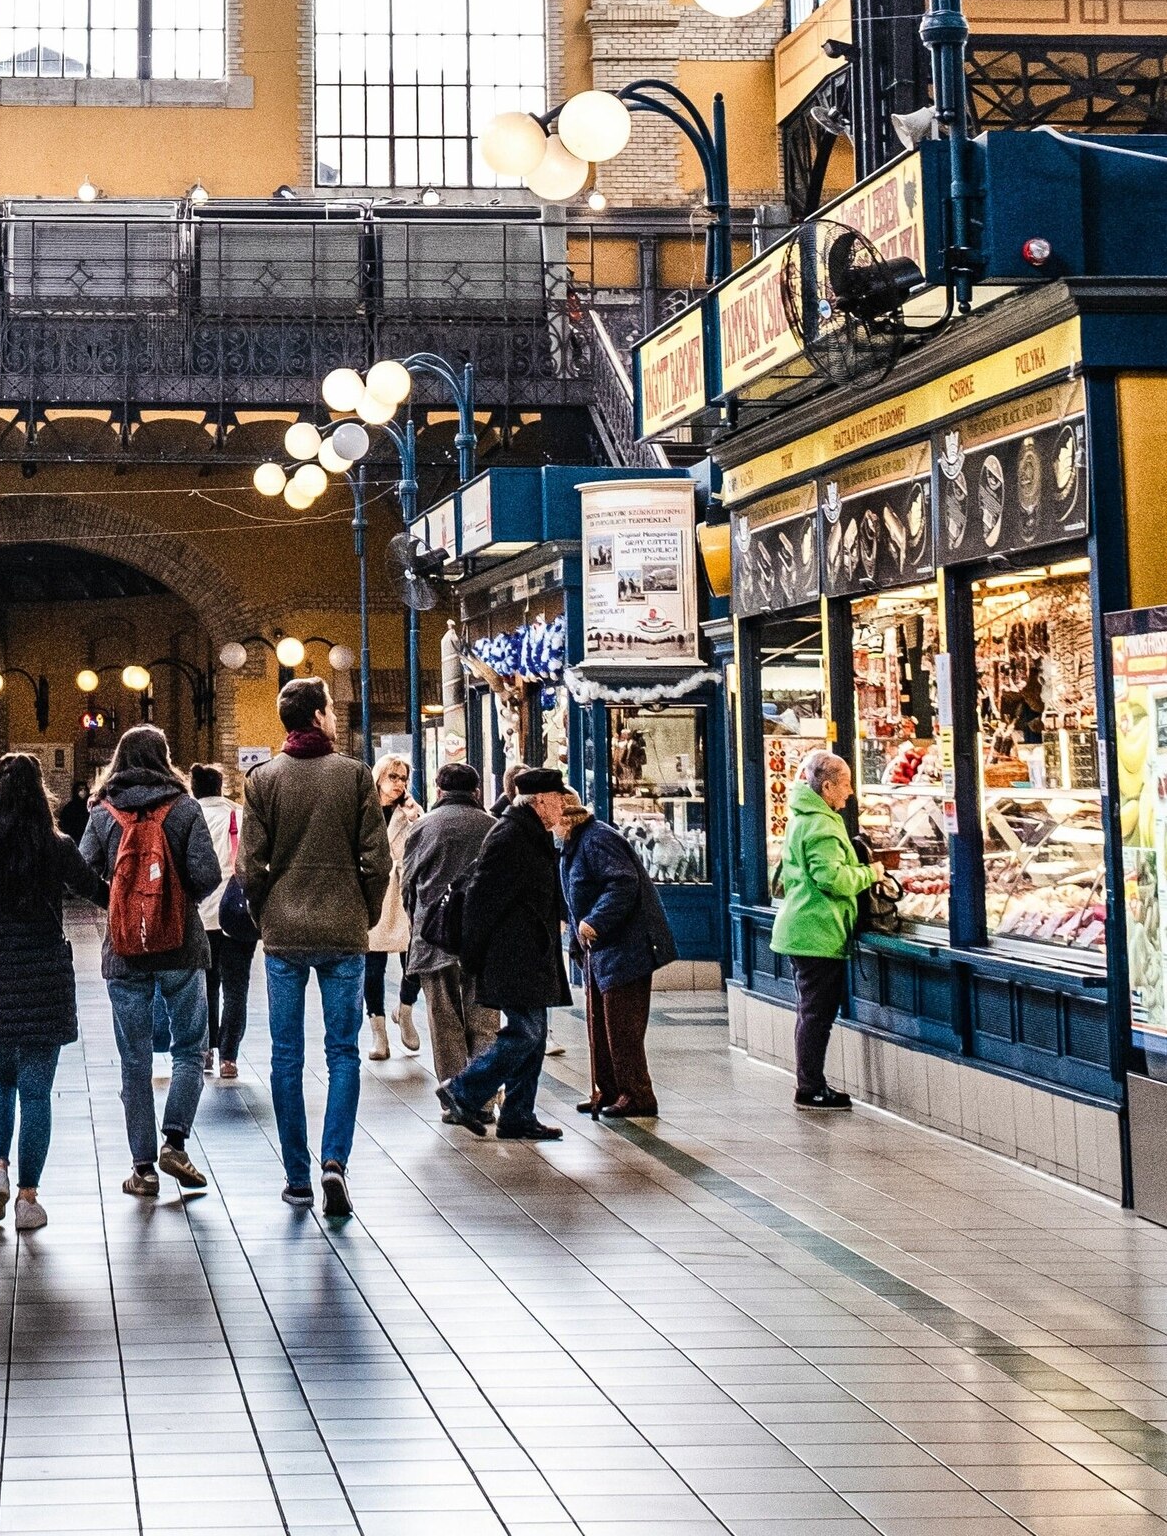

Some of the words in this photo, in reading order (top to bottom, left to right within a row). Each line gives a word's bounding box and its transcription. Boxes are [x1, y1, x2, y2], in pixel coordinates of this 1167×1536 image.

[722, 289, 760, 368] TANYASI
[670, 335, 702, 406] BAROMFI
[1015, 346, 1046, 377] PULYKA
[949, 374, 975, 403] CSIRKE
[642, 530, 678, 538] Hungarian
